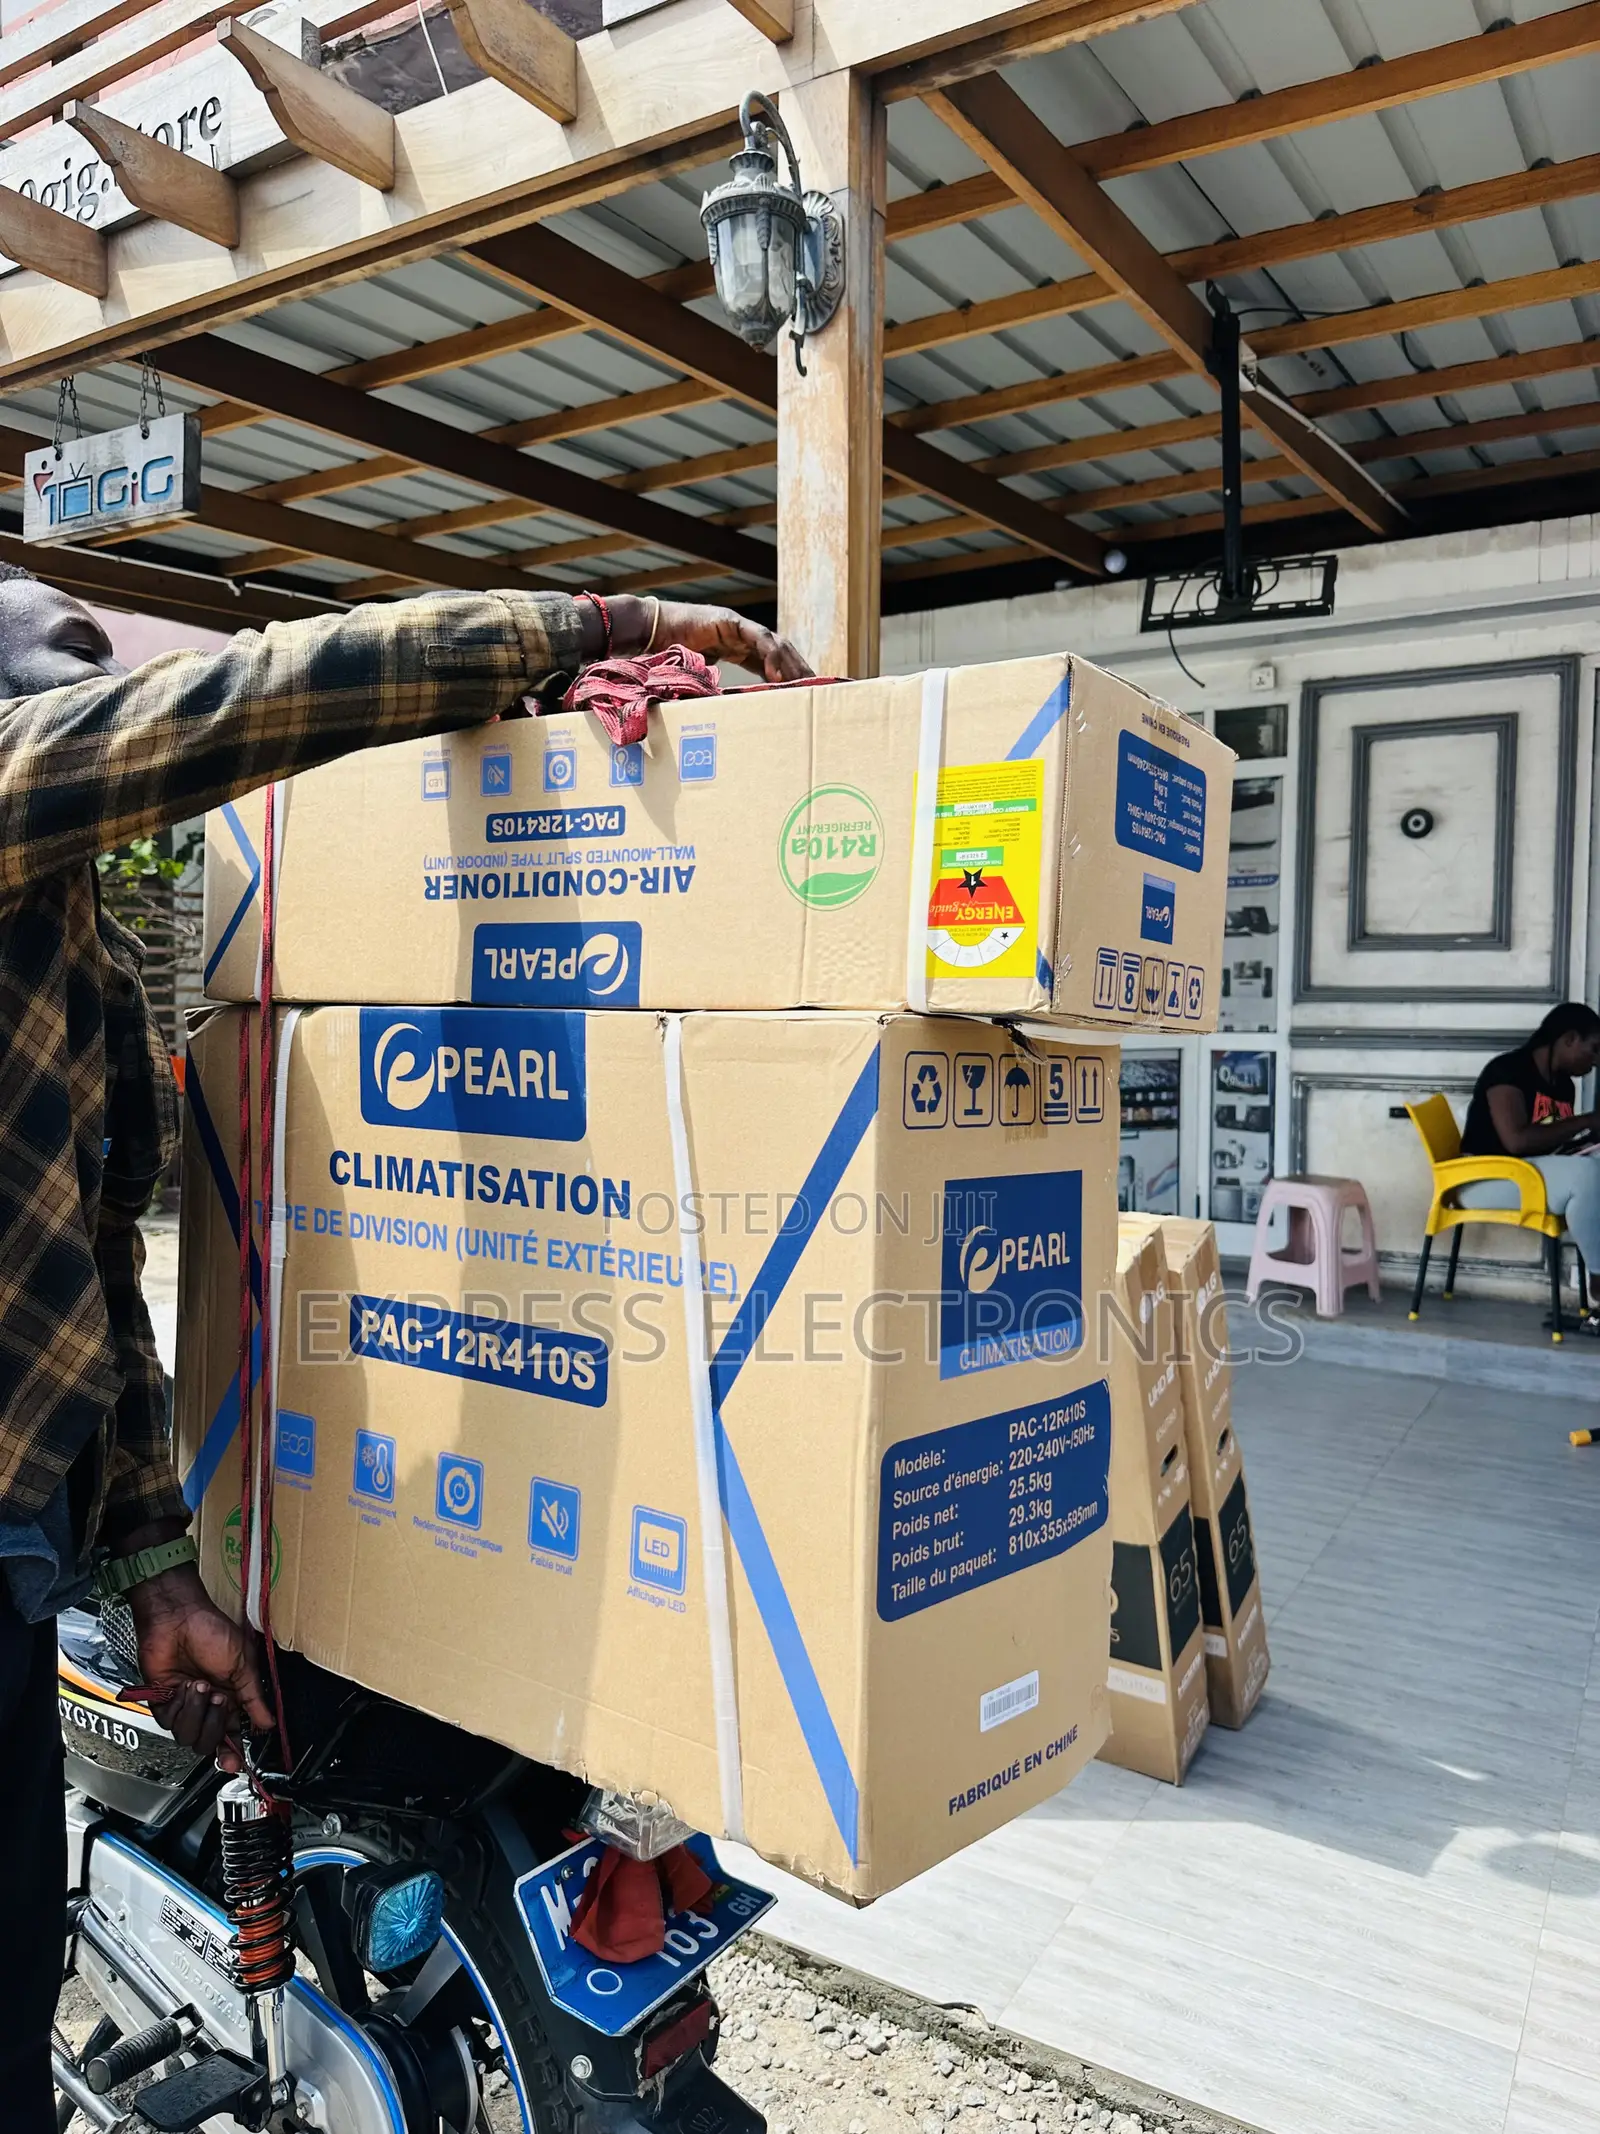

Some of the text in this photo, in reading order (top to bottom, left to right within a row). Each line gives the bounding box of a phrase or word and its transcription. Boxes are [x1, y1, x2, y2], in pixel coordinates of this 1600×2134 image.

[491, 810, 620, 837] PAC-12R410S
[795, 821, 873, 836] REFRIGERANT
[423, 844, 697, 871] WALL-MOUNTED SPLIT TYPE (INDOOR UNIT)
[791, 833, 877, 860] R410a
[423, 864, 697, 901] AIR-CONDITIONER
[970, 875, 977, 886] 1
[929, 901, 1014, 923] ENERGY guide
[1144, 905, 1163, 922] PEARL
[483, 947, 578, 981] PEARL
[436, 1045, 570, 1101] PEARL
[1049, 1063, 1063, 1101] 5
[328, 1148, 632, 1220] CLIMATISATION
[313, 1207, 343, 1237] DE
[349, 1211, 448, 1252] DIVISION
[455, 1227, 539, 1266] (UNITÉ
[1000, 1231, 1071, 1275] PEARL
[360, 1309, 597, 1391] PAC-12R410S
[959, 1326, 1071, 1371] CLIMATISATION
[893, 1399, 1087, 1479] Modèle: PAC-12R410S
[892, 1422, 1096, 1510] Source d'énergie: 220-240V~/50Hz
[892, 1470, 1052, 1541] Poids net: 25.5kg
[644, 1537, 670, 1559] LED
[890, 1500, 1098, 1602] Taille du paquet: 810x355x595mm
[891, 1498, 1052, 1572] Poids brut: 29.3kg
[1229, 1512, 1247, 1564] 65
[529, 1553, 573, 1576] Faible bruit
[1169, 1547, 1192, 1603] 65
[626, 1585, 687, 1614] Affichage LED
[948, 1723, 1078, 1817] FABRIQUÉ EN CHINE
[727, 1892, 763, 1916] GH
